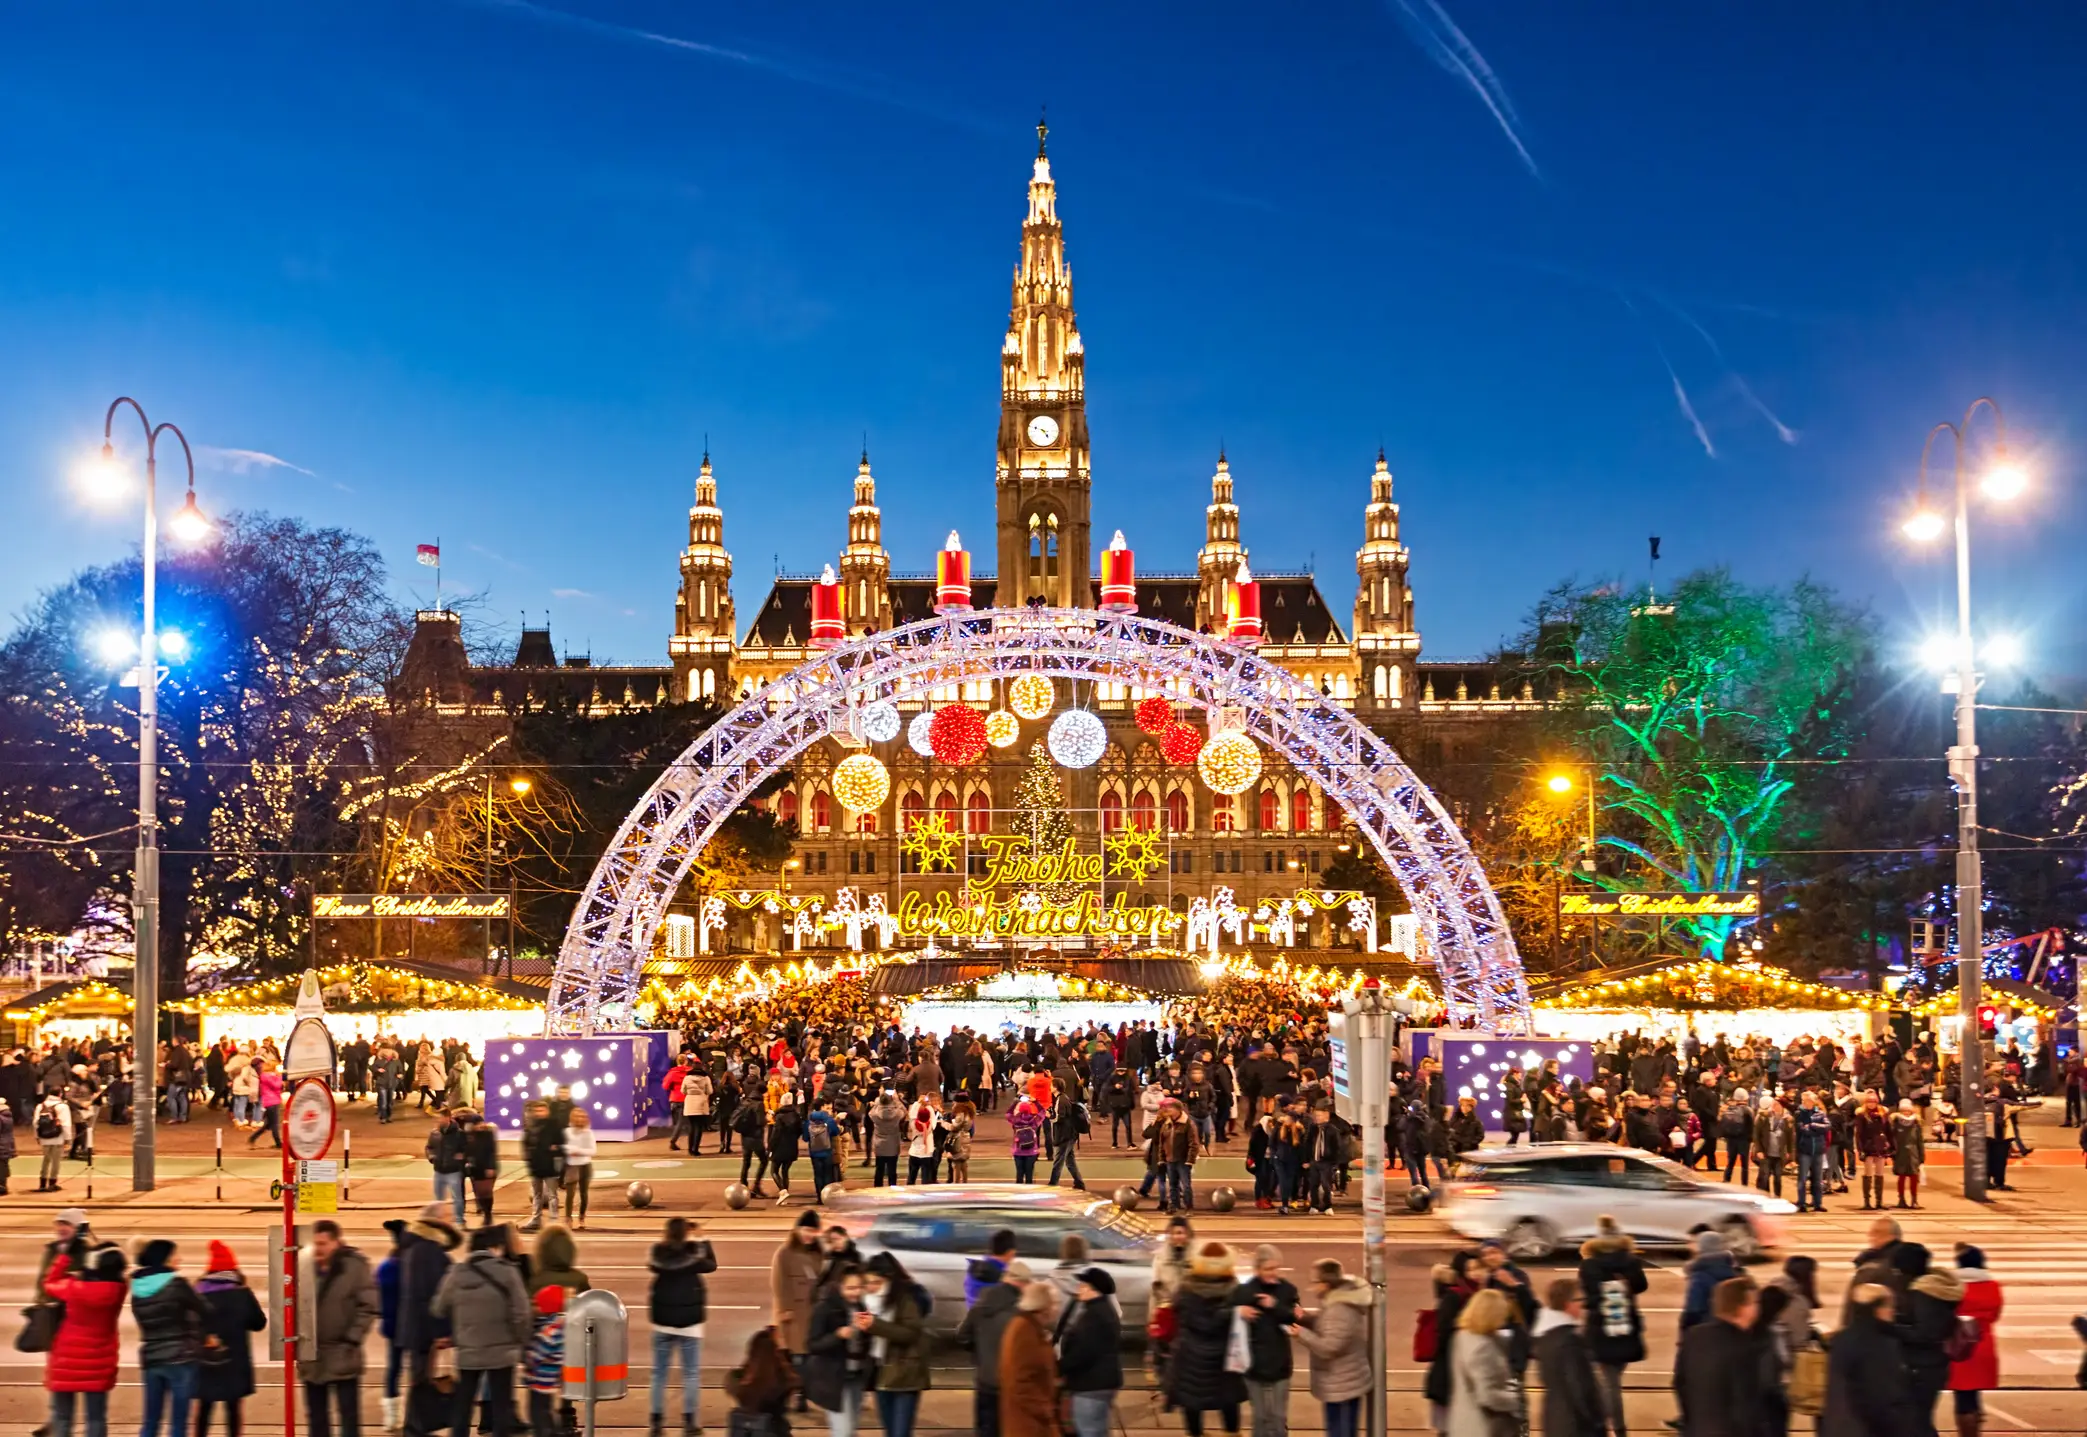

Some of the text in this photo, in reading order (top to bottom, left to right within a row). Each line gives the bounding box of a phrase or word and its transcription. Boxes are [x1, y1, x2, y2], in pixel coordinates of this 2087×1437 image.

[968, 835, 1103, 891] Frohe
[313, 896, 370, 916] Wiener
[899, 890, 1172, 936] Weihnachten
